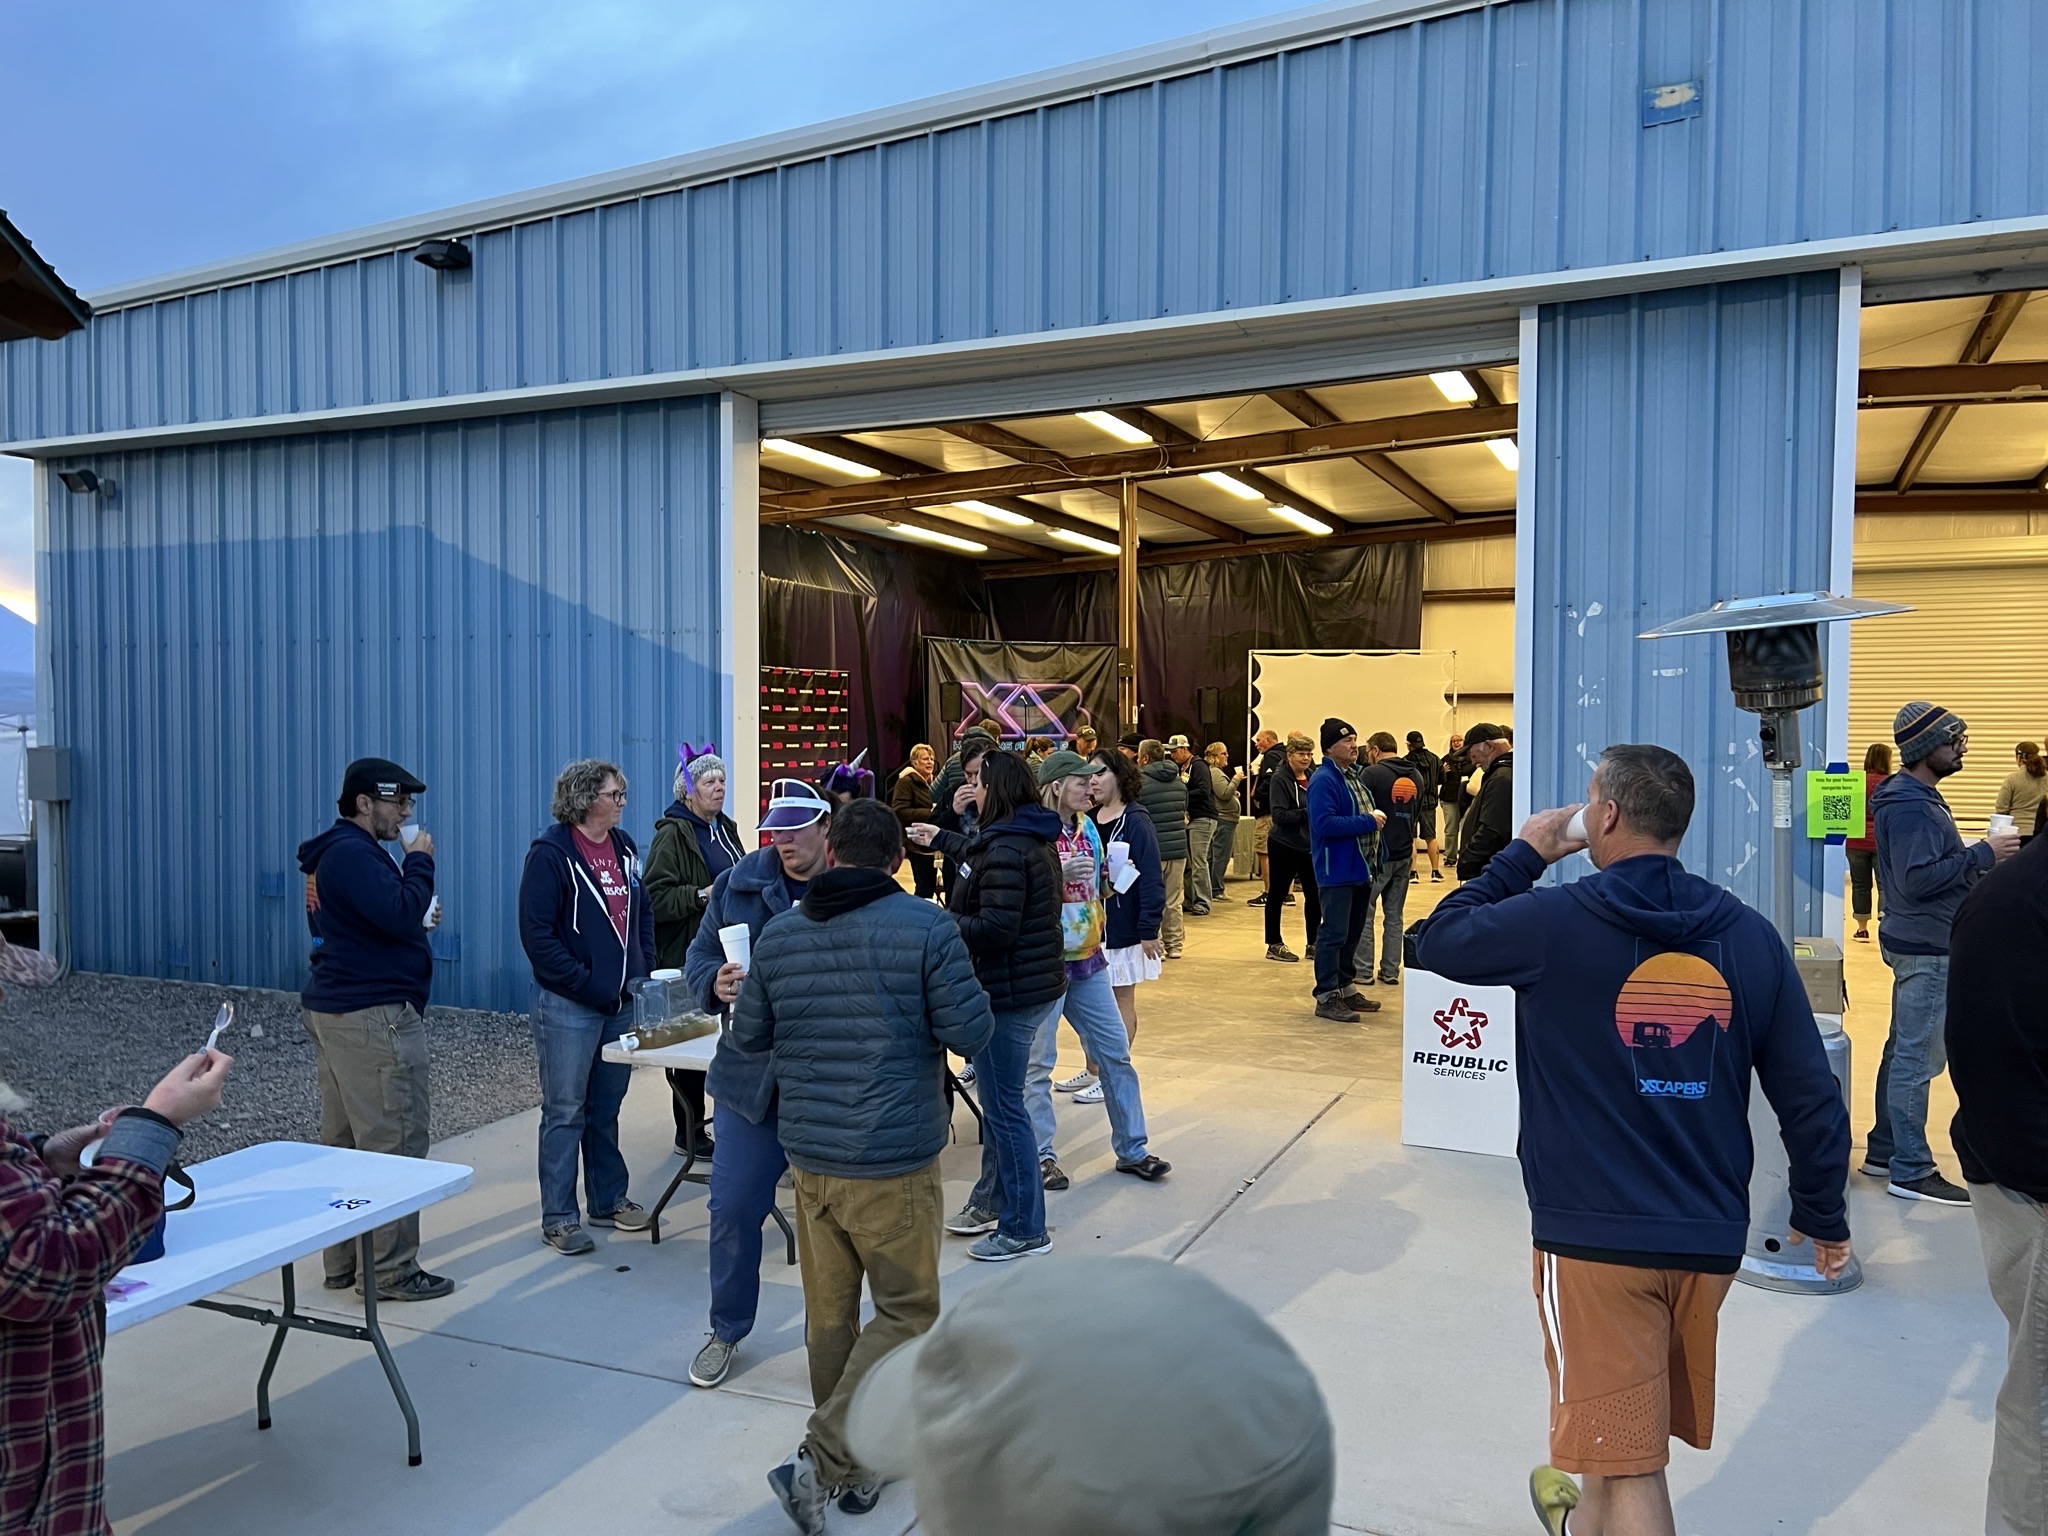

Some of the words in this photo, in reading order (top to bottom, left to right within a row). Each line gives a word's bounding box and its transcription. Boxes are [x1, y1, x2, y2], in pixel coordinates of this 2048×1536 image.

[1413, 1051, 1509, 1073] REPUBLIC
[1433, 1067, 1487, 1081] SERVICES
[1639, 1078, 1707, 1095] XSCAPERS
[335, 1198, 372, 1210] 26
